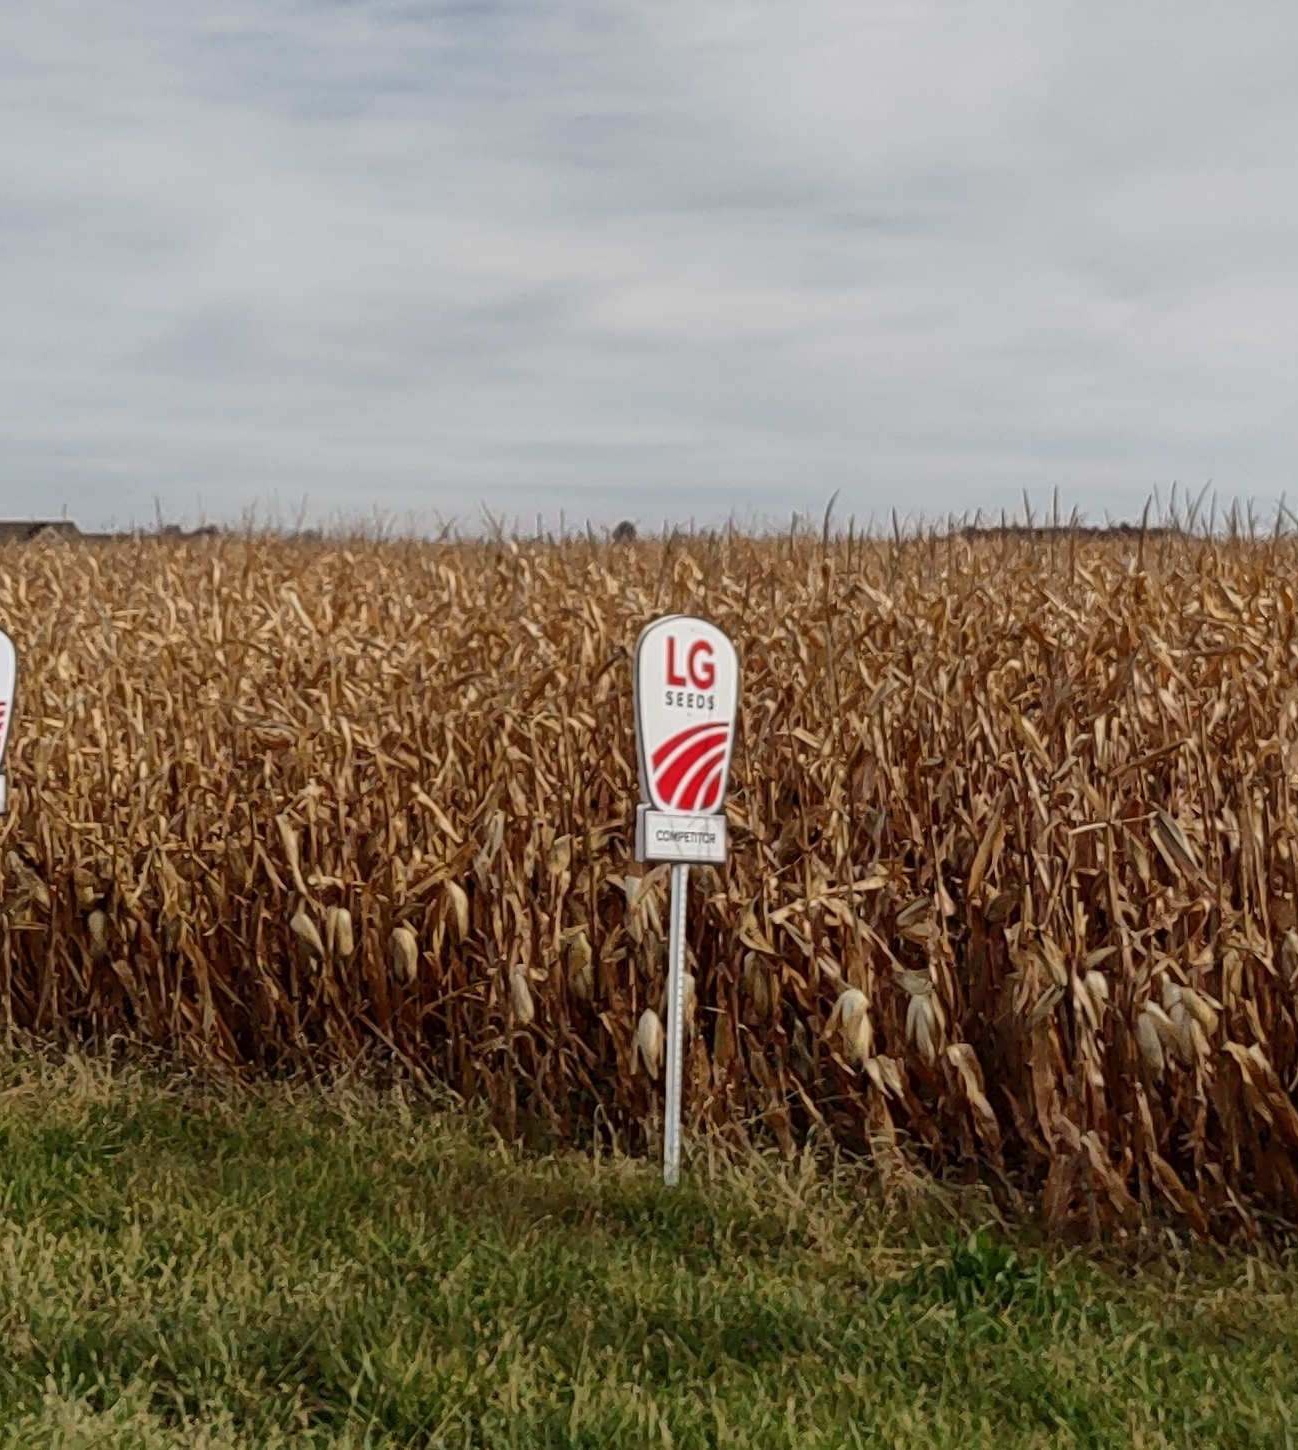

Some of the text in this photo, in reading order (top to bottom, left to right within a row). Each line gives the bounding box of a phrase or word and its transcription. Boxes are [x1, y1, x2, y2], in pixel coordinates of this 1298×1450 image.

[666, 635, 715, 691] LG
[665, 691, 715, 710] SEEDS
[655, 829, 716, 845] COMPETITOR
